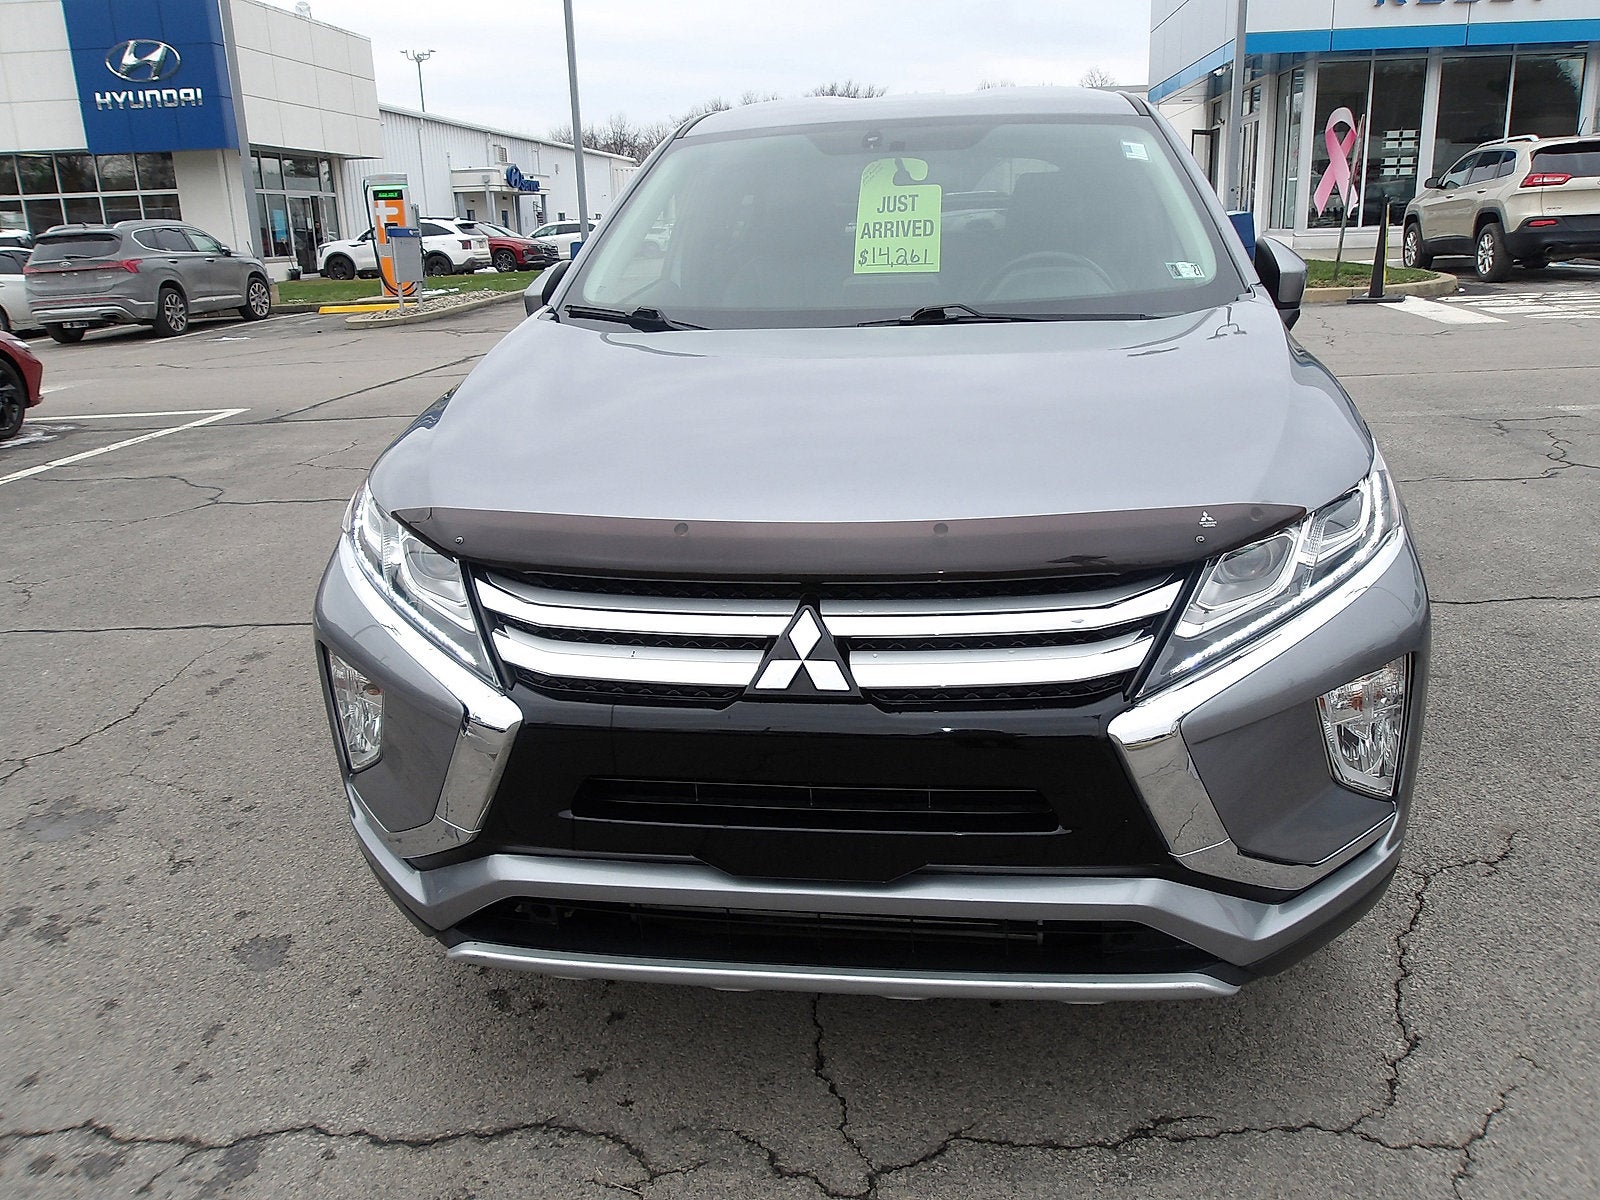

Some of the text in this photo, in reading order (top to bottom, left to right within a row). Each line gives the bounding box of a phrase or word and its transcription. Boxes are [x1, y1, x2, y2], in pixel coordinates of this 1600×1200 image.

[94, 88, 204, 111] HYUNDAI
[877, 194, 919, 213] JUST
[861, 219, 935, 239] ARRIVED
